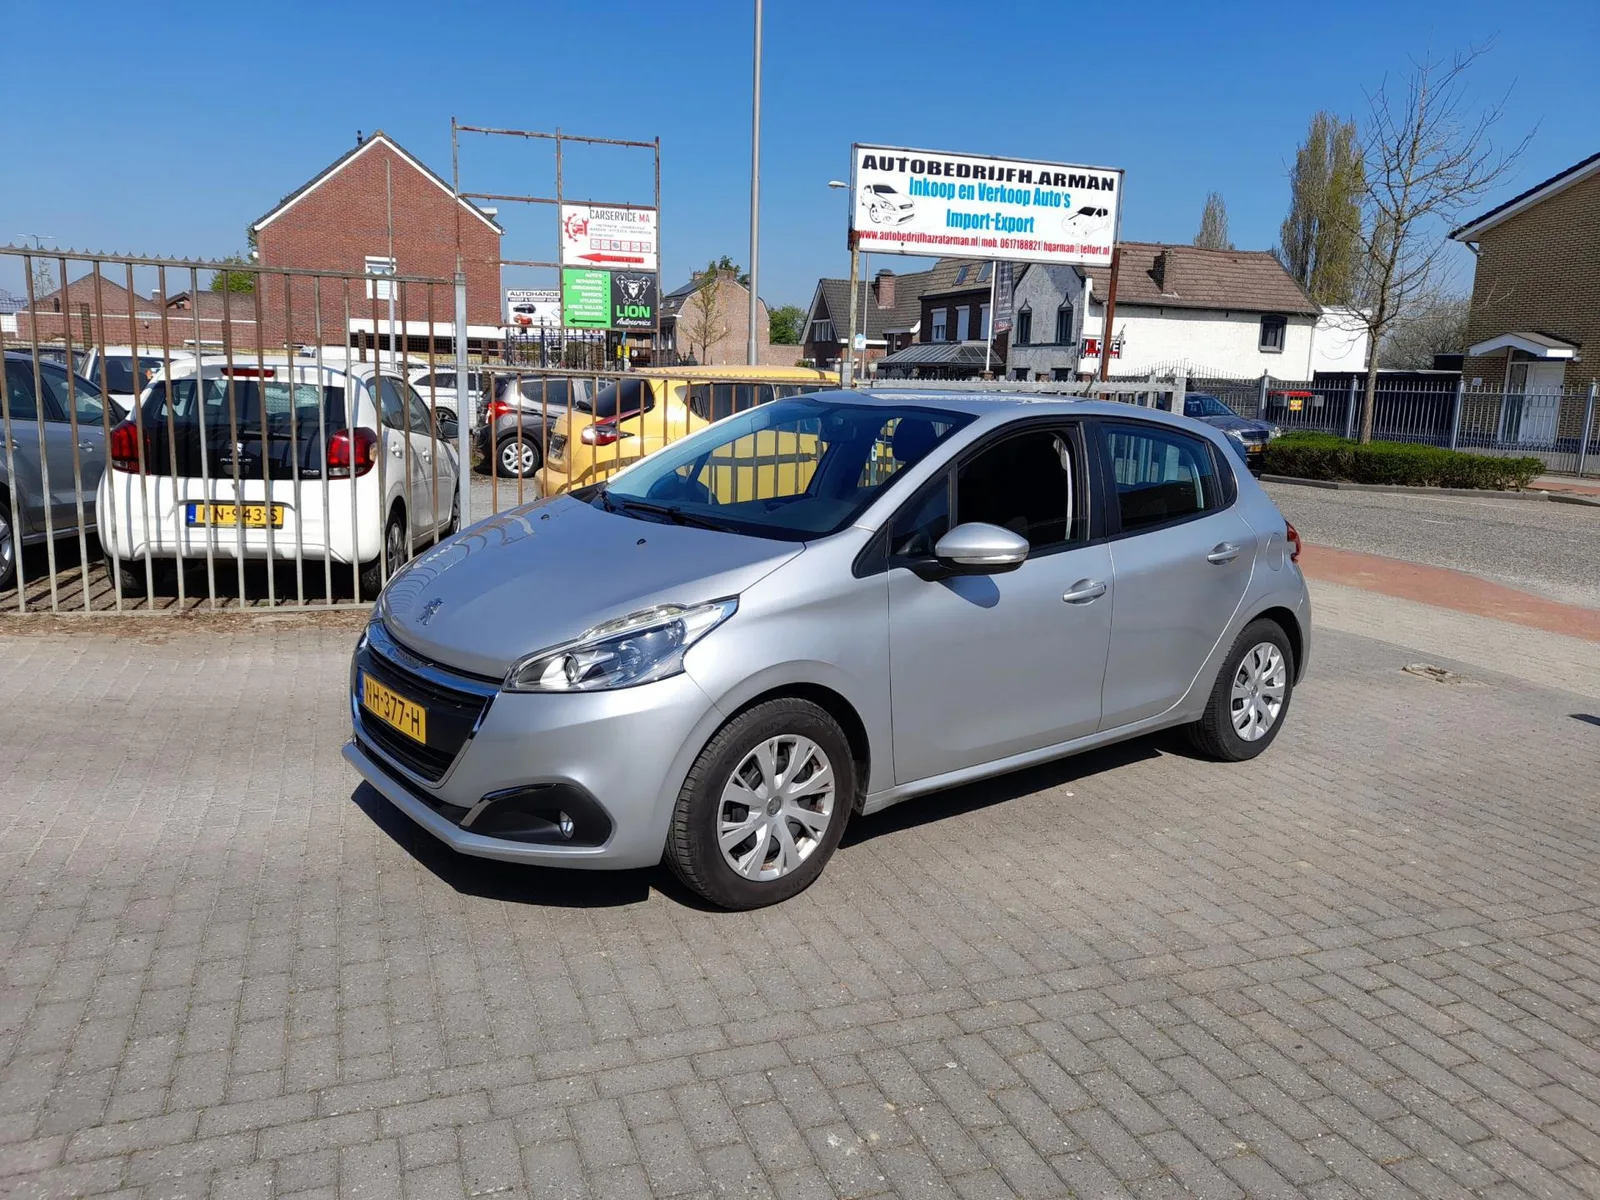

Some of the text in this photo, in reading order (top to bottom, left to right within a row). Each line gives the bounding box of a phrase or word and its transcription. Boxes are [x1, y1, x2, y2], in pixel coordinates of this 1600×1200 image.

[909, 176, 1071, 208] Inkoop en Verkoop Auto's
[590, 209, 650, 223] CARSERVICE MA
[946, 208, 1035, 234] Import-Export
[616, 304, 651, 318] LION
[365, 677, 420, 736] NH-377-H
